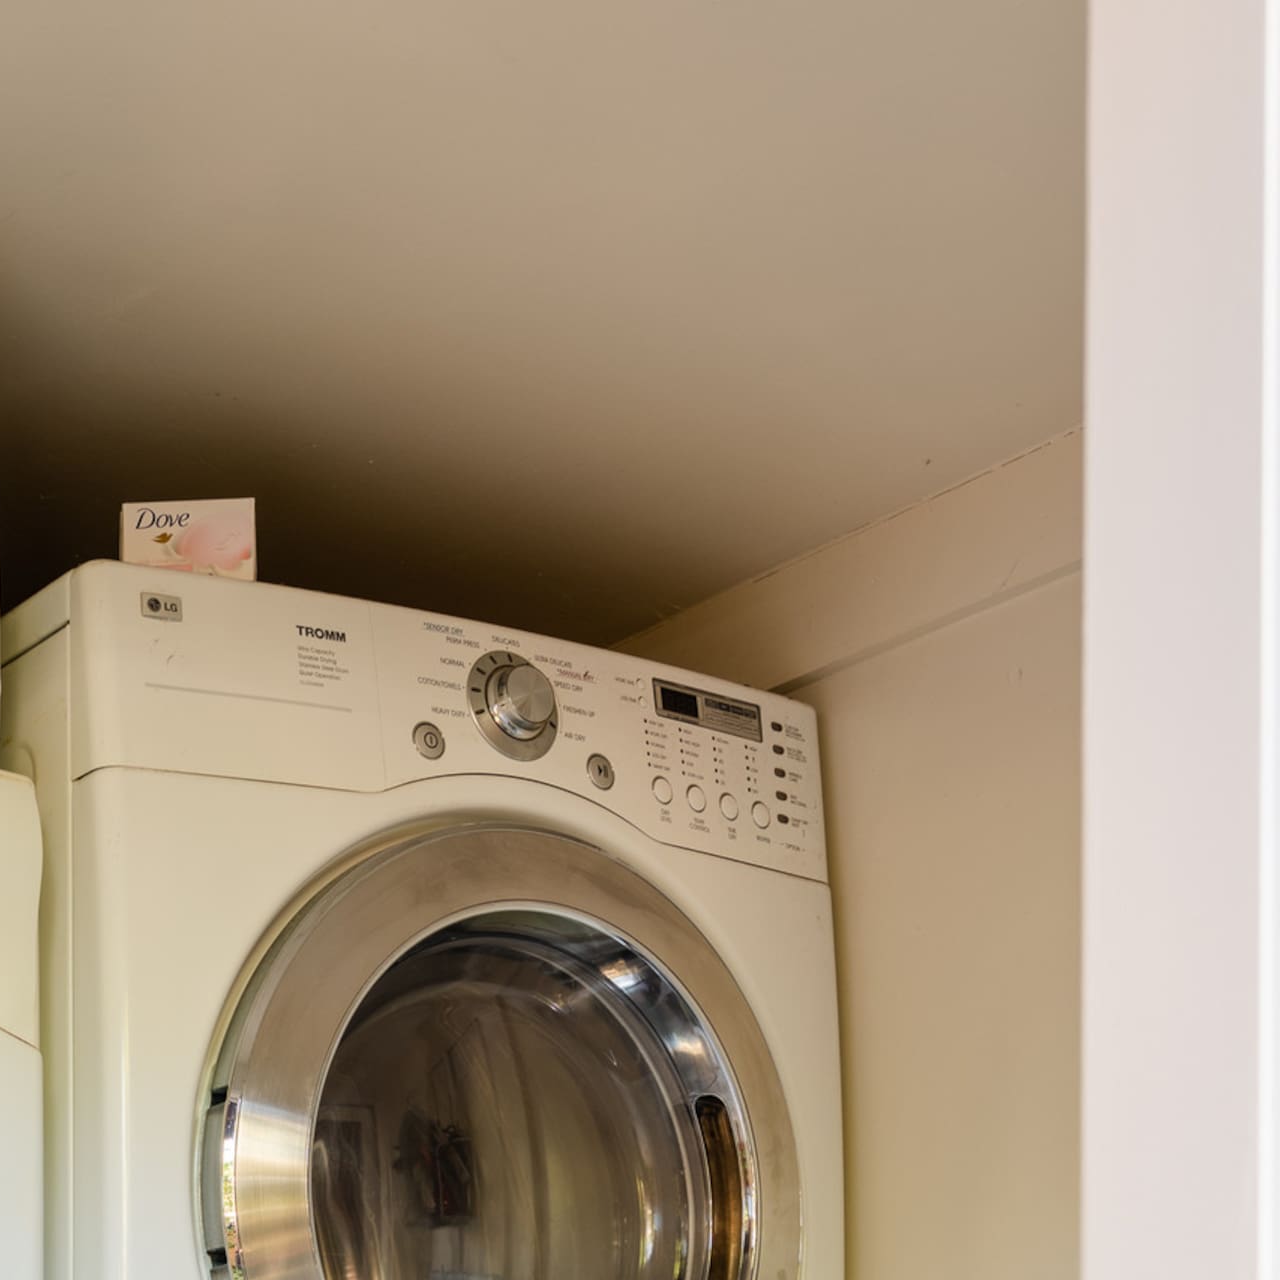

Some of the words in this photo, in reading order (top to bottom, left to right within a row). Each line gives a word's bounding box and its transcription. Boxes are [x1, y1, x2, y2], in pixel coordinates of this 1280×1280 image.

[136, 507, 190, 530] Dove
[296, 625, 346, 643] TROMM
[440, 657, 465, 668] NORMAL
